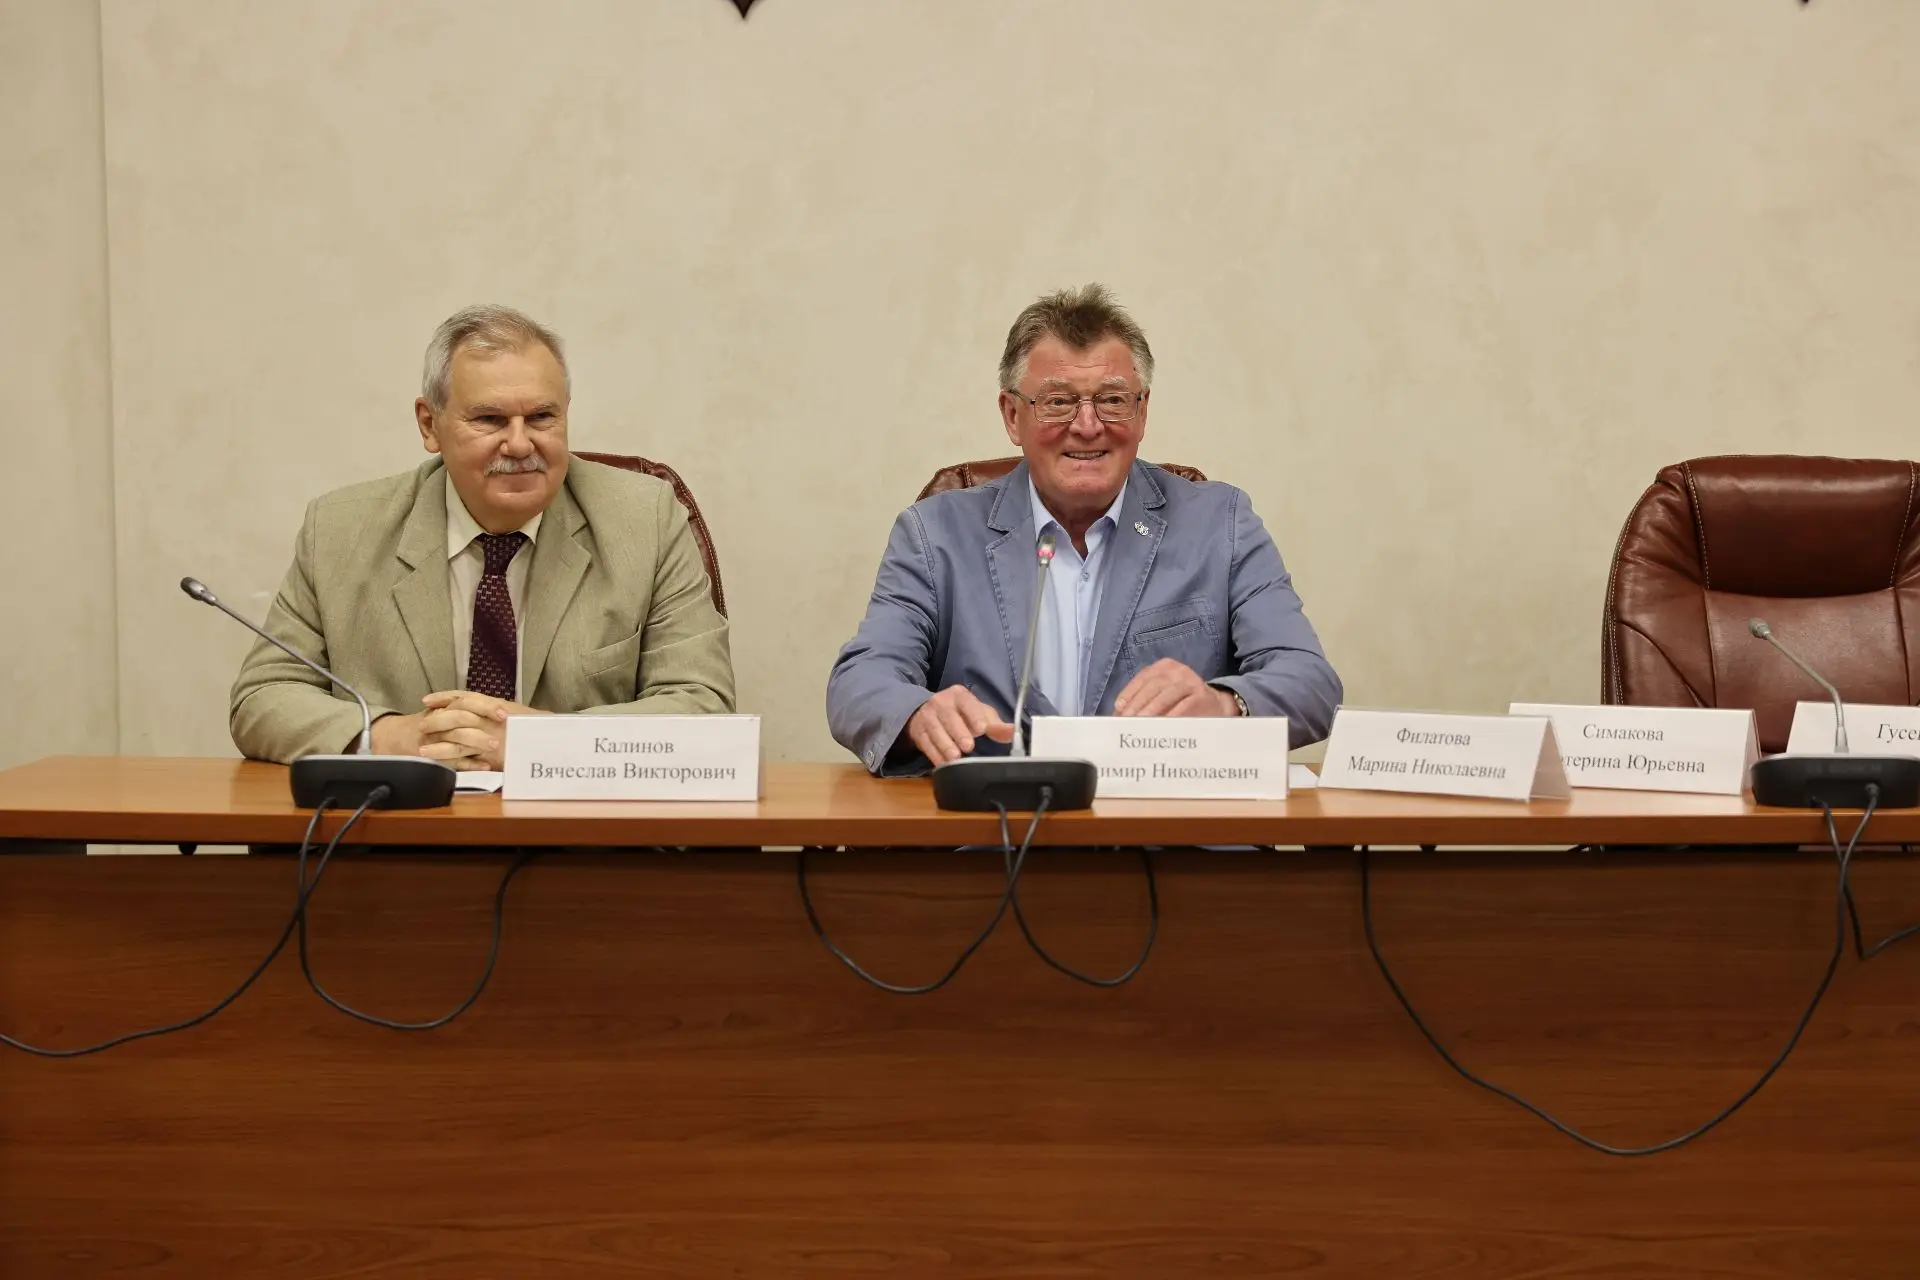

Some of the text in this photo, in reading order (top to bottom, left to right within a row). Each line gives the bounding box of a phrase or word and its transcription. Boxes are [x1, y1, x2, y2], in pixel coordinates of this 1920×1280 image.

[1119, 733, 1197, 749] Кошелев
[1396, 727, 1471, 746] Филатова
[1582, 723, 1664, 741] Симакова
[594, 738, 675, 753] Калинов
[530, 762, 736, 783] Вячеслав Викторович
[1098, 763, 1259, 782] имир Николаевич
[1348, 756, 1506, 779] Марина Николаевна
[1562, 754, 1705, 774] терина Юрьевна
